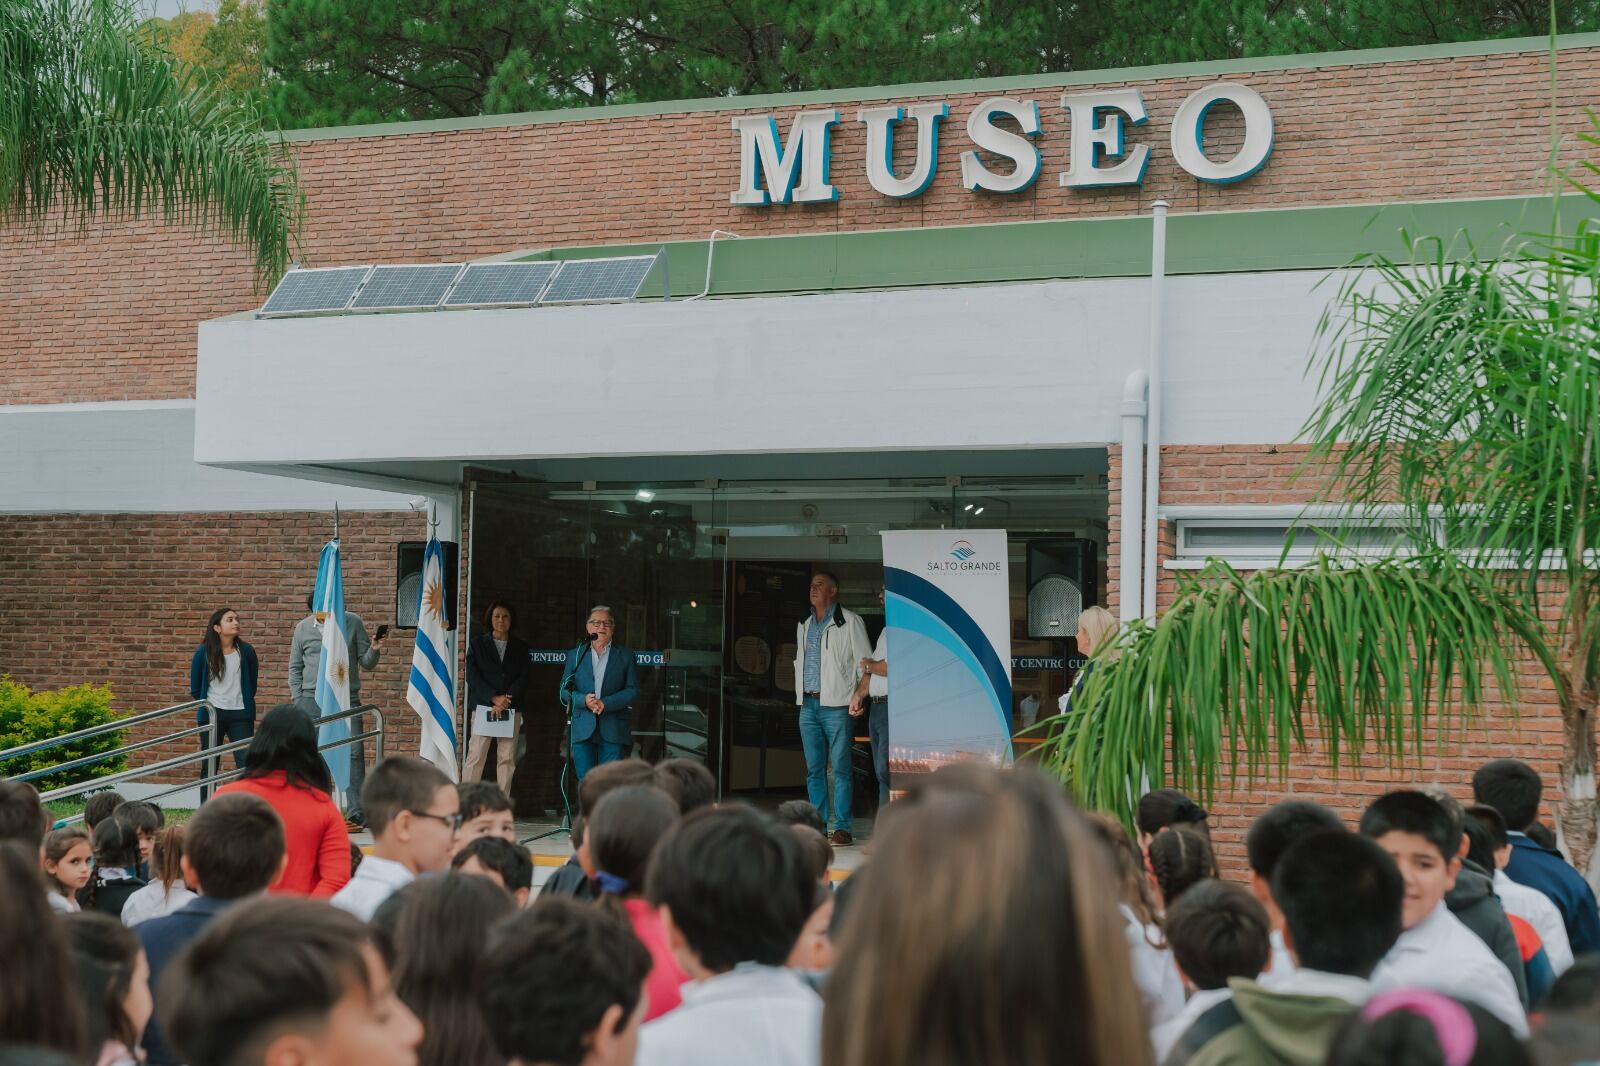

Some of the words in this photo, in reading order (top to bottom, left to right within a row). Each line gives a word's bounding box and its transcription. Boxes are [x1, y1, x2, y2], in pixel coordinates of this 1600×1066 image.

[729, 82, 1275, 207] MUSEO
[927, 561, 958, 571] SALTO
[960, 561, 1001, 571] GRANDE
[1011, 658, 1018, 668] Y
